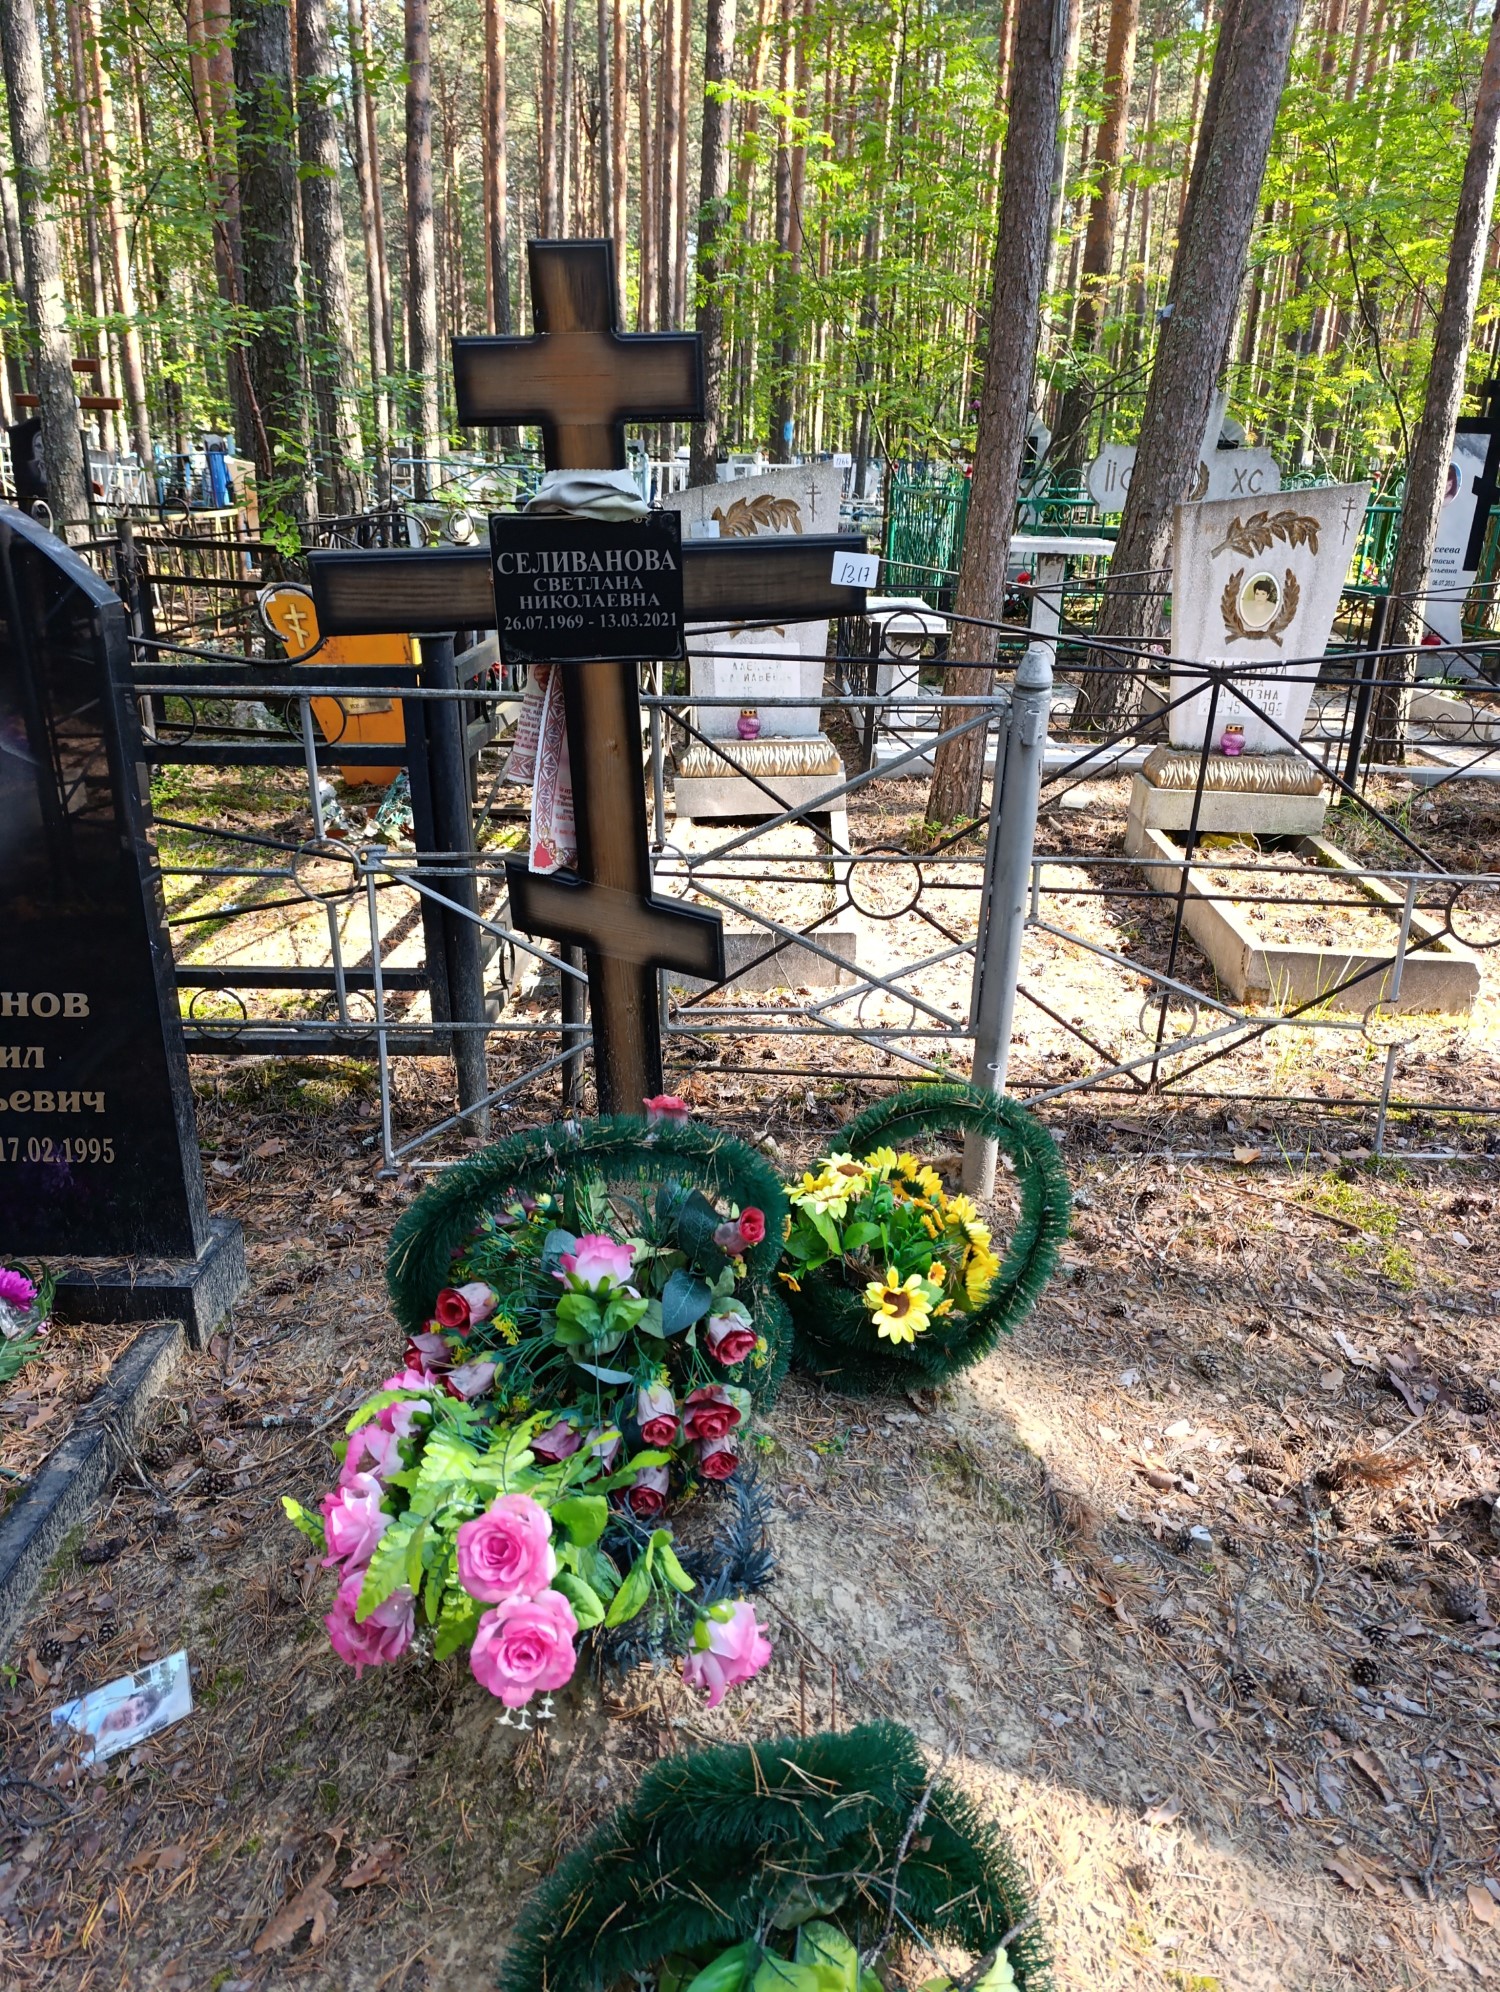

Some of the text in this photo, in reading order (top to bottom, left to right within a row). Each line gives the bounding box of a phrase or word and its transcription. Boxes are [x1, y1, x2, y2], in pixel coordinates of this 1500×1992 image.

[496, 549, 677, 575] СЕЛИВАНОВА
[533, 576, 644, 592] СВЕТЛАНА
[519, 593, 661, 610] НИКОЛАЕВНА
[503, 614, 584, 631] 26.07.1969
[600, 612, 677, 629] 13.03.2021
